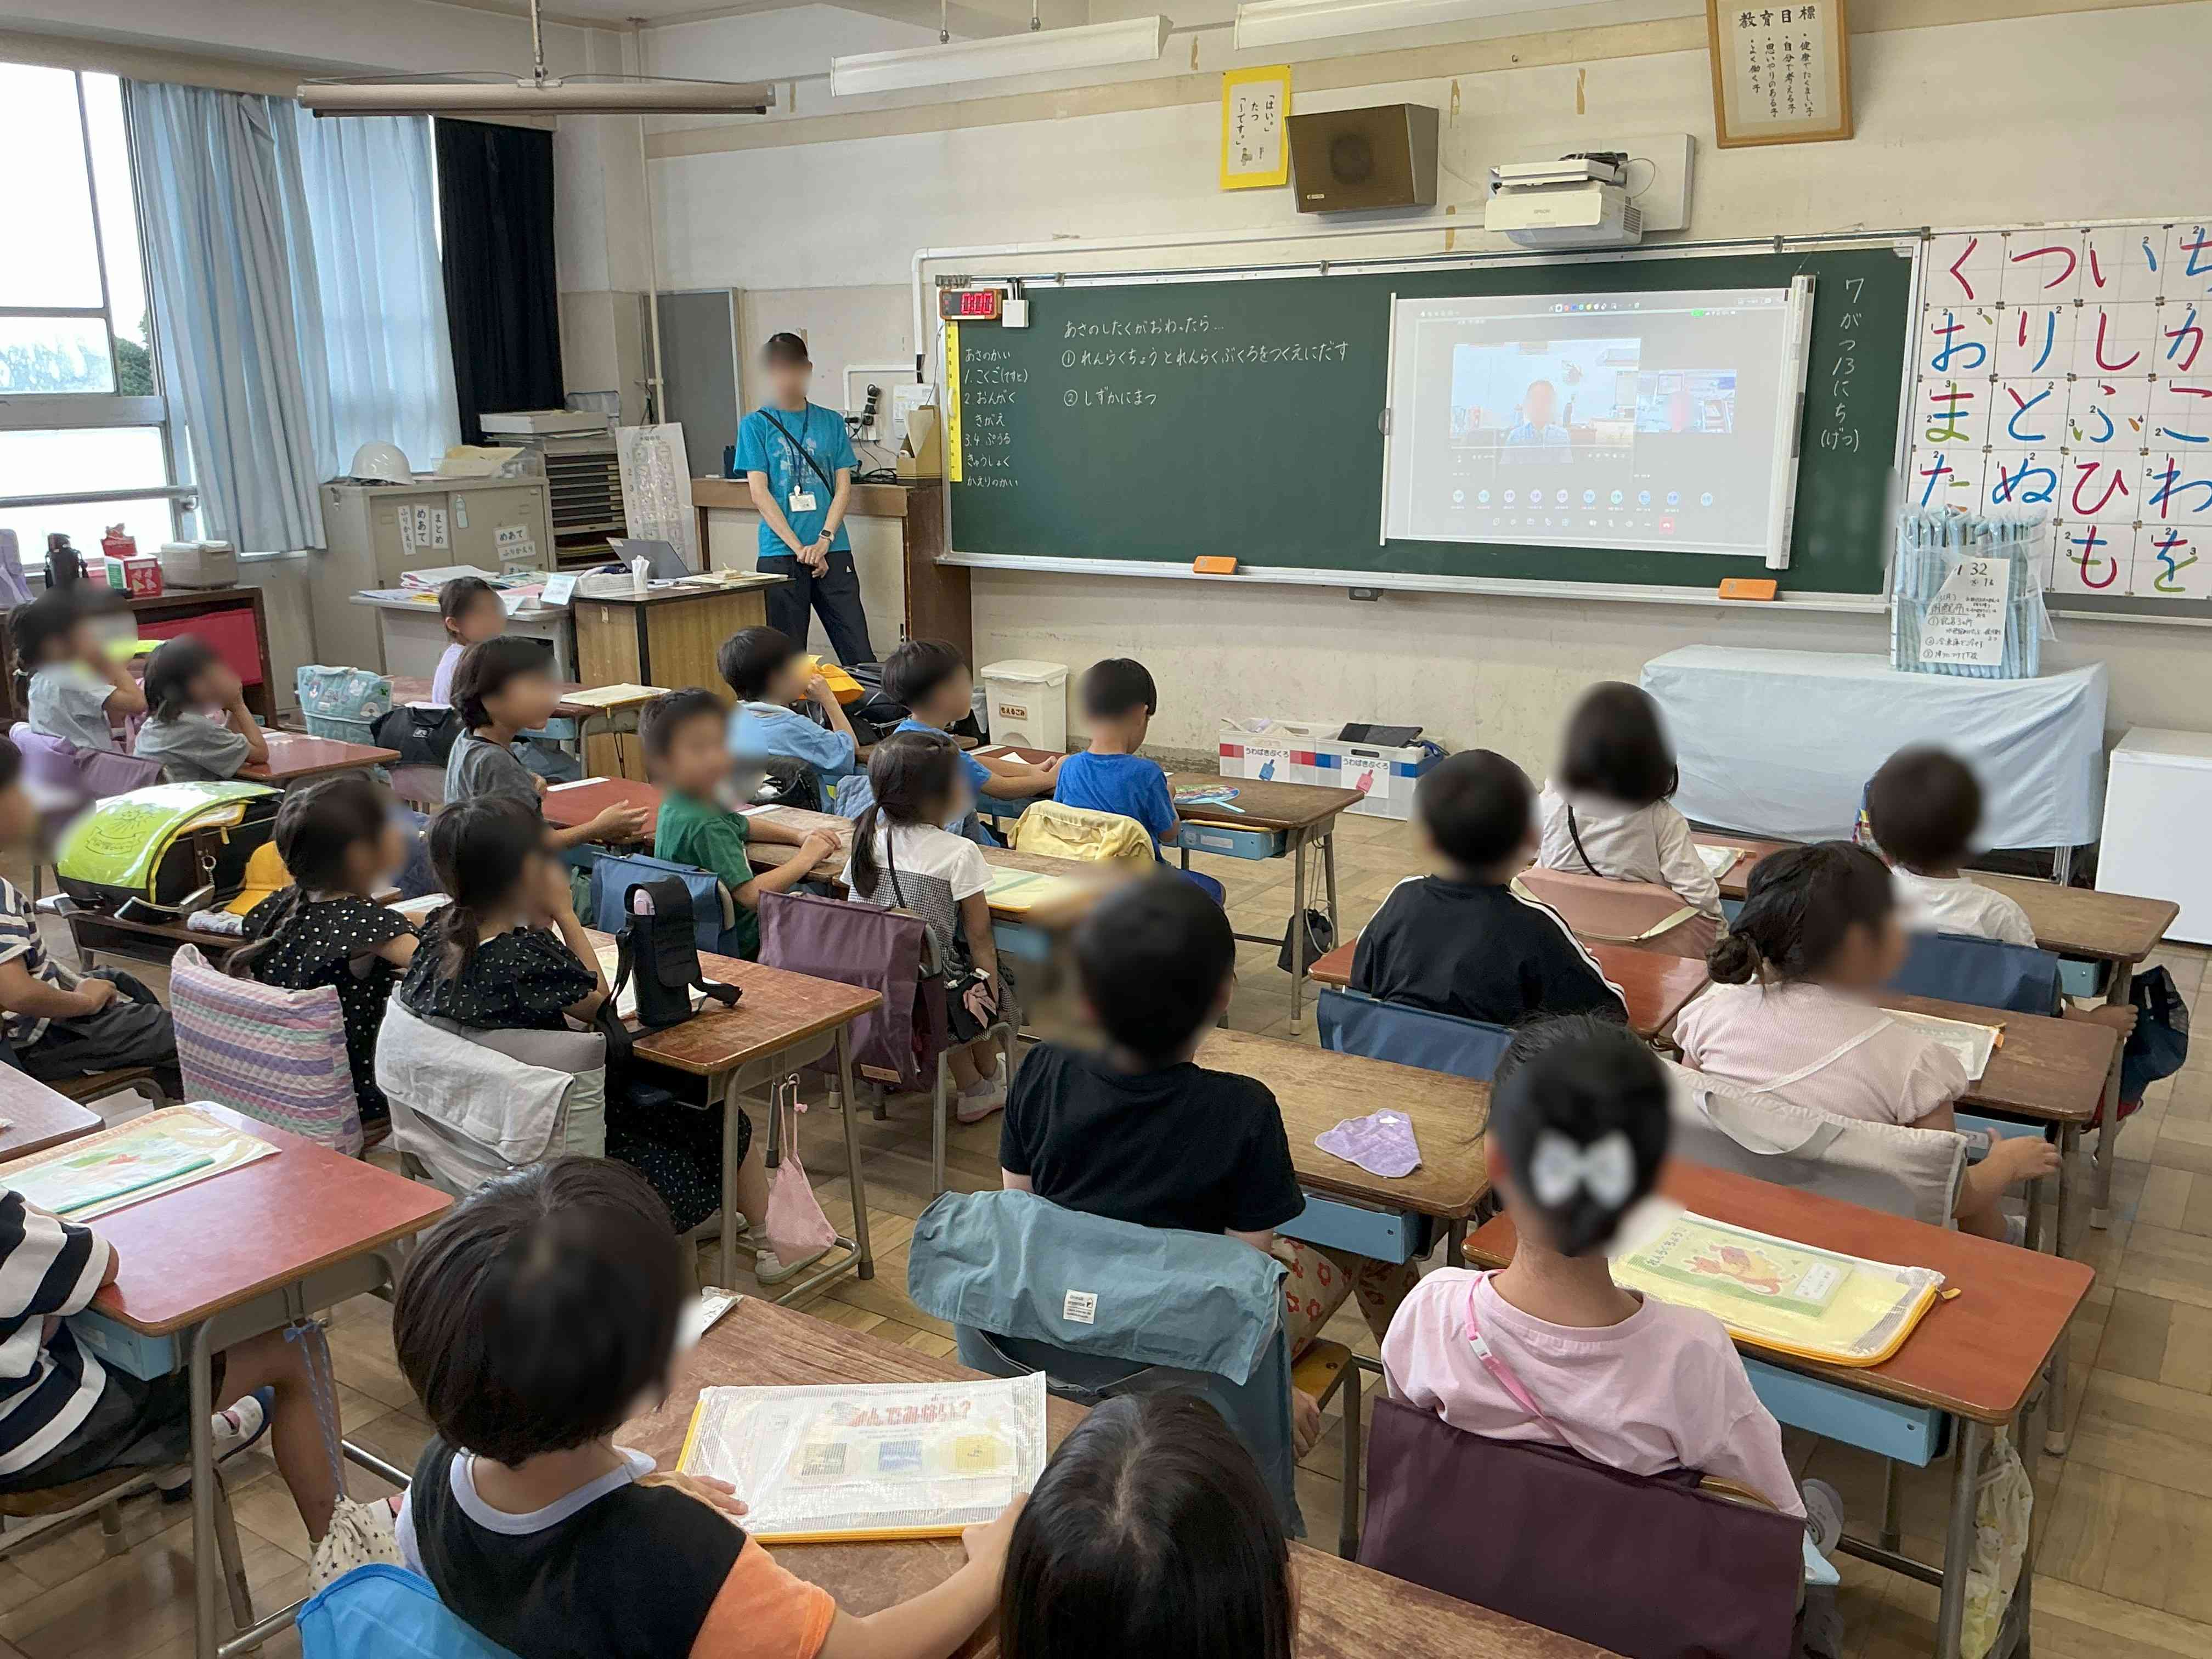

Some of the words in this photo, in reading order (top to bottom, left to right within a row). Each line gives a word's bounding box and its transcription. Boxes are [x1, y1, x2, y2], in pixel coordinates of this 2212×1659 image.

[1738, 5, 1816, 29] 教育目標
[1251, 101, 1260, 121] たつ
[1950, 238, 1977, 300] く
[2011, 246, 2076, 289] つ
[2090, 244, 2157, 288] い
[961, 293, 993, 315] 0:00
[965, 347, 1011, 362] あさのかい
[1931, 312, 1993, 372] お
[2018, 311, 2055, 373] り
[2096, 312, 2140, 371] し
[975, 413, 1006, 427] きがえ
[1925, 382, 1974, 442] ま
[2007, 387, 2051, 441] と
[2073, 385, 2140, 443] ふ
[2137, 415, 2144, 423] 4
[2162, 387, 2212, 443] こ
[967, 453, 1010, 467] きゅうしょく
[1992, 458, 2057, 504] ぬ
[967, 475, 1018, 488] かえりのかい
[1920, 454, 1970, 512] た
[2072, 462, 2129, 515] ひ
[2148, 457, 2212, 519] わ
[400, 509, 412, 550] ふりかえり
[417, 509, 426, 543] めあて
[435, 513, 444, 545] まとめ
[500, 530, 523, 541] めあて
[2071, 525, 2117, 589] も
[2154, 529, 2198, 592] を
[2190, 547, 2197, 555] 3
[1001, 707, 1025, 716] もえるごみ
[1245, 745, 1289, 758] うわばきぶくろ
[1342, 758, 1389, 770] うわばきぶくろ
